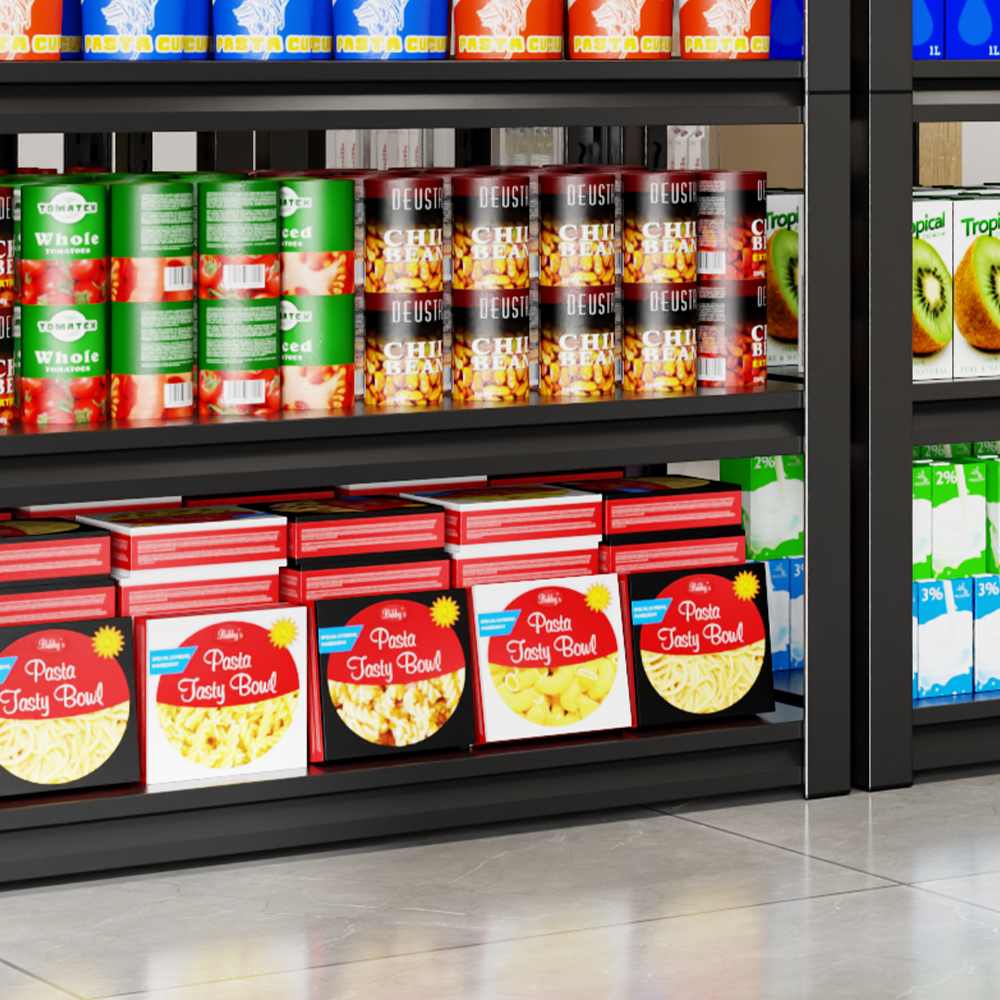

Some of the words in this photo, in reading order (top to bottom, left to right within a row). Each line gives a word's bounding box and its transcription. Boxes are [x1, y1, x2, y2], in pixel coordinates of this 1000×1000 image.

[84, 34, 154, 54] PASTA
[216, 35, 283, 54] PASTA
[336, 35, 402, 54] PASTA
[574, 35, 639, 53] PASTA
[929, 46, 941, 56] 1L
[989, 46, 1000, 56] 1L
[39, 203, 96, 212] TOMATEX
[912, 211, 945, 239] pical
[961, 212, 1000, 237] Tropi
[35, 232, 99, 247] Whole
[39, 321, 96, 330] TOMATEX
[35, 350, 99, 365] Whole
[754, 456, 775, 469] 2%
[936, 470, 957, 485] 2%
[921, 587, 943, 602] 3%
[978, 582, 1000, 597] 3%
[678, 600, 721, 622] Pasta
[527, 611, 572, 634] Pasta
[369, 627, 416, 650] Pasta
[657, 626, 699, 653] Tasty
[702, 621, 744, 645] Bowl
[506, 639, 550, 666] Tasty
[553, 634, 597, 657] Bowl
[203, 648, 252, 672] Pasta
[346, 655, 393, 683] Tasty
[396, 650, 441, 674] Bowl
[25, 659, 76, 682] Pasta
[178, 677, 225, 705] Tasty
[229, 671, 277, 696] Bowl
[0, 688, 49, 717] Tasty
[53, 682, 104, 708] Bowl
